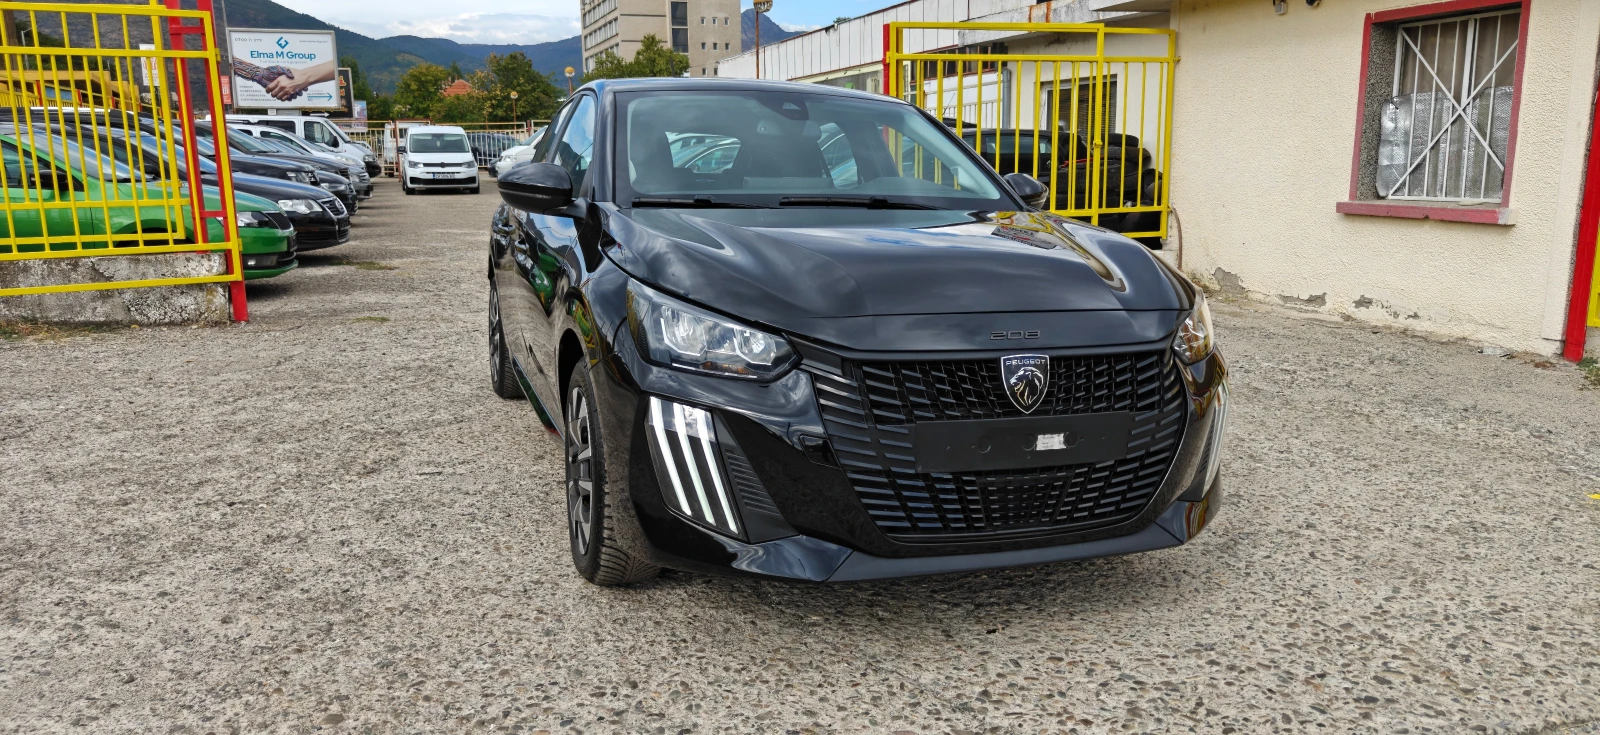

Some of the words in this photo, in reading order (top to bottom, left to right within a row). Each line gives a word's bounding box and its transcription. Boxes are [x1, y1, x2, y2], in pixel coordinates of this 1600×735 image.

[250, 50, 274, 59] Elma
[275, 51, 285, 59] M
[286, 51, 316, 61] Group
[990, 330, 1041, 340] 208
[1005, 358, 1046, 366] PEUGEOT
